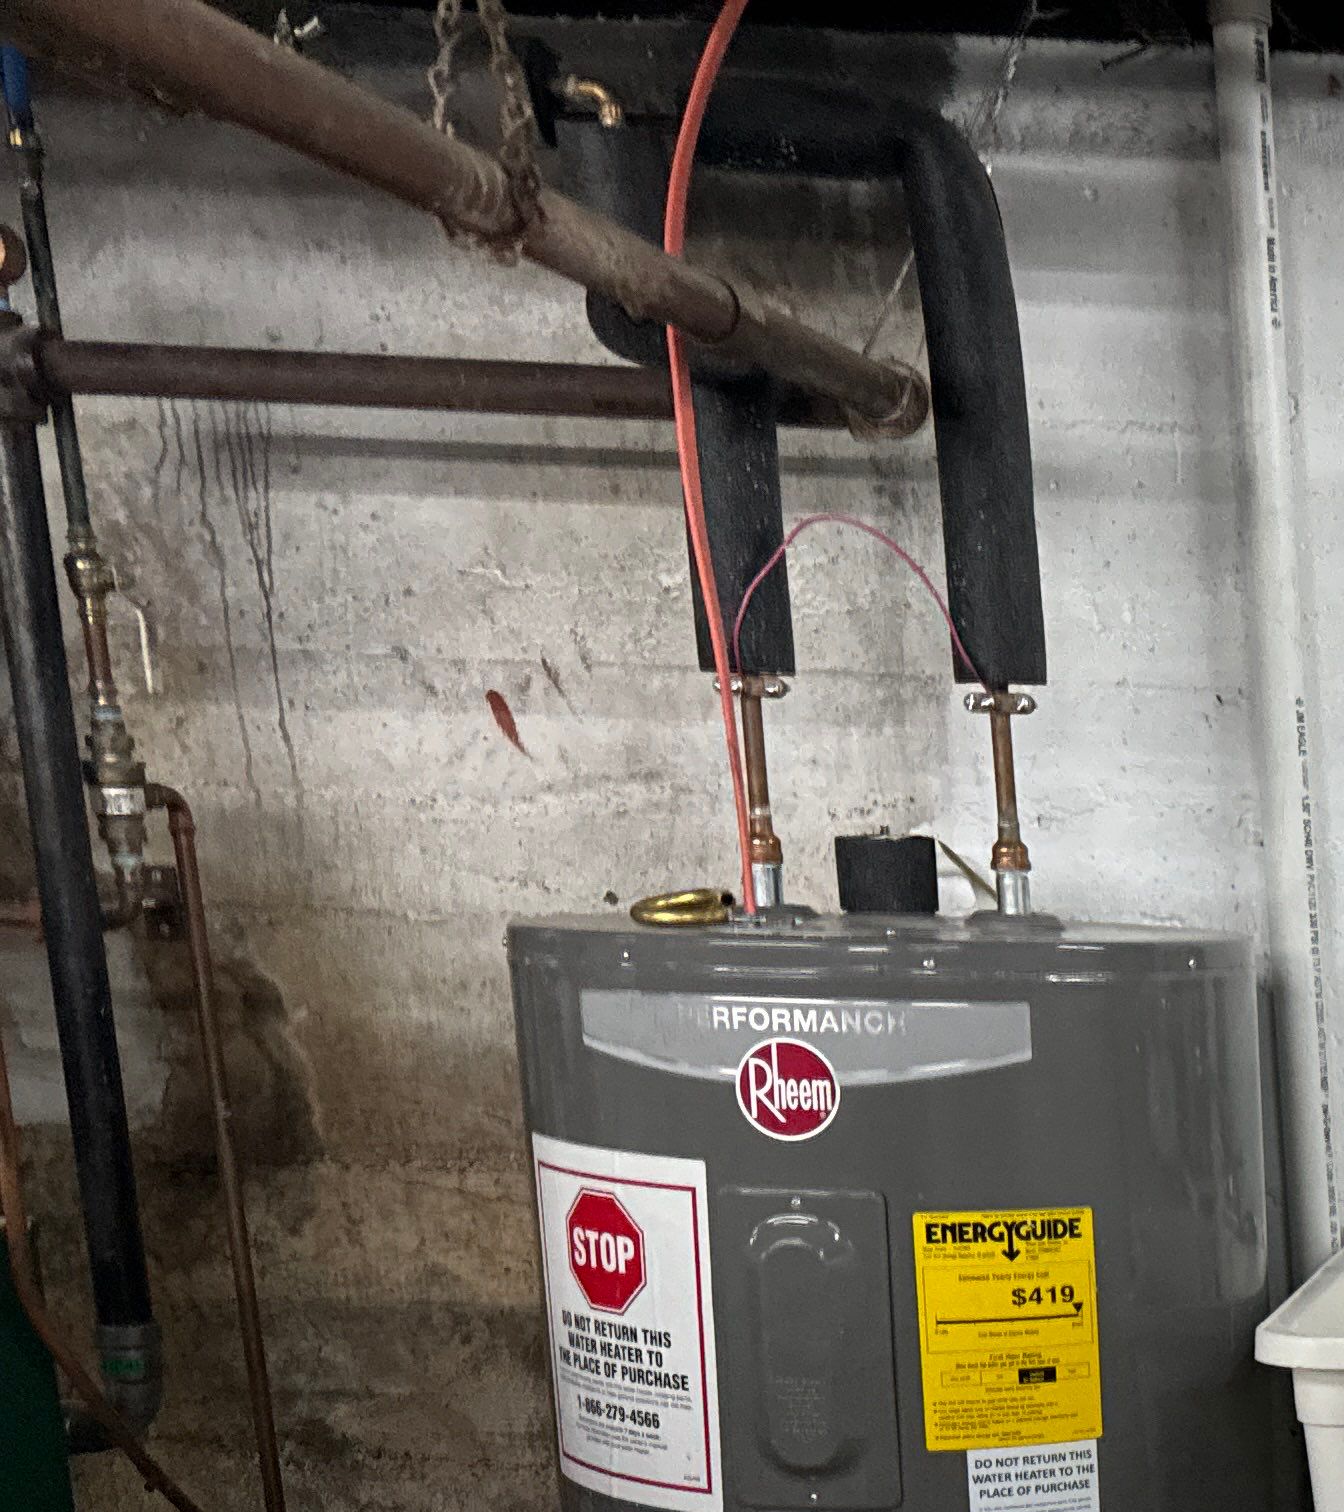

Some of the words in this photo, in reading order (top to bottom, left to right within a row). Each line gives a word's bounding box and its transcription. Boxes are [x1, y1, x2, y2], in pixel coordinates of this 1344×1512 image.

[1297, 725, 1308, 757] EAGLE
[676, 1003, 906, 1034] RFORMANC
[749, 1042, 832, 1123] Rheem
[573, 1226, 635, 1274] STOP
[1011, 1285, 1075, 1308] $419
[574, 1313, 591, 1333] NOT
[594, 1319, 637, 1343] RETURN
[641, 1328, 672, 1348] THIS
[568, 1332, 597, 1355] WATER
[600, 1342, 643, 1364] HEATER
[649, 1350, 663, 1368] TO
[559, 1346, 572, 1366] THE
[573, 1353, 601, 1376] PLACE
[604, 1362, 617, 1379] OF
[621, 1366, 690, 1391] PURCHASE
[972, 1472, 1012, 1484] WATER
[1015, 1468, 1056, 1481] HEATER
[1059, 1466, 1073, 1477] TO
[1075, 1463, 1095, 1474] THE
[974, 1459, 992, 1469] DO
[995, 1456, 1019, 1468] NOT
[1022, 1452, 1066, 1466] RETURN
[1068, 1449, 1092, 1461] THIS
[979, 1487, 1013, 1499] PLACE
[1016, 1485, 1032, 1496] OF
[1034, 1479, 1091, 1494] PURCHASE
